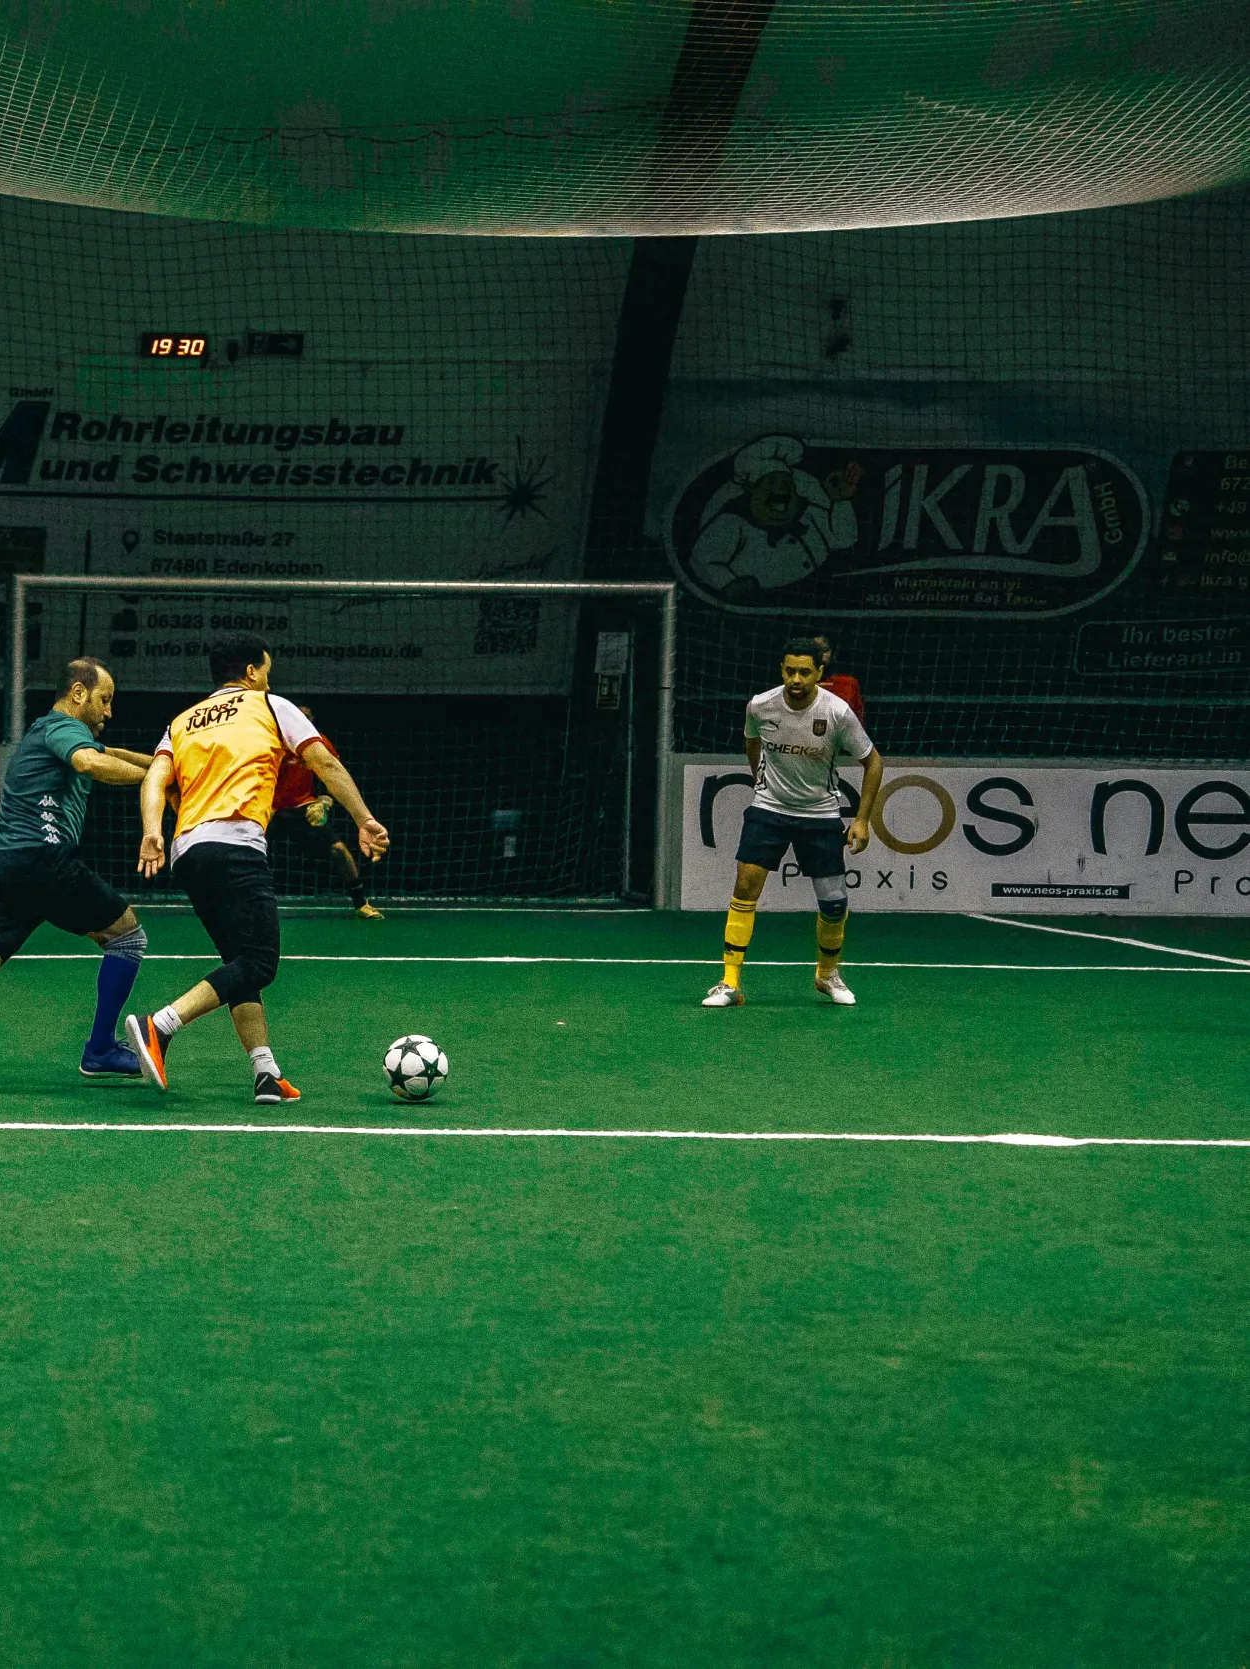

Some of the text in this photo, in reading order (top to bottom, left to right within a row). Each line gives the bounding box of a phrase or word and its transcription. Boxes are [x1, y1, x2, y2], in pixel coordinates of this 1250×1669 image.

[151, 338, 205, 357] 19 30
[52, 412, 405, 450] Rohrleitungsbau
[39, 454, 499, 487] und Schweisstechnik
[1093, 480, 1124, 546] GmbH
[271, 531, 296, 547] 27
[213, 559, 324, 576] Edenkoben
[147, 613, 203, 630] 06323
[1162, 624, 1240, 643] bester
[1108, 649, 1212, 669] Lieferant
[186, 707, 238, 732] JUMP
[766, 742, 825, 757] CHECK24
[699, 772, 1036, 857] nos
[782, 863, 948, 890] Paxis
[1002, 885, 1120, 898] www.neos-praxis.de
